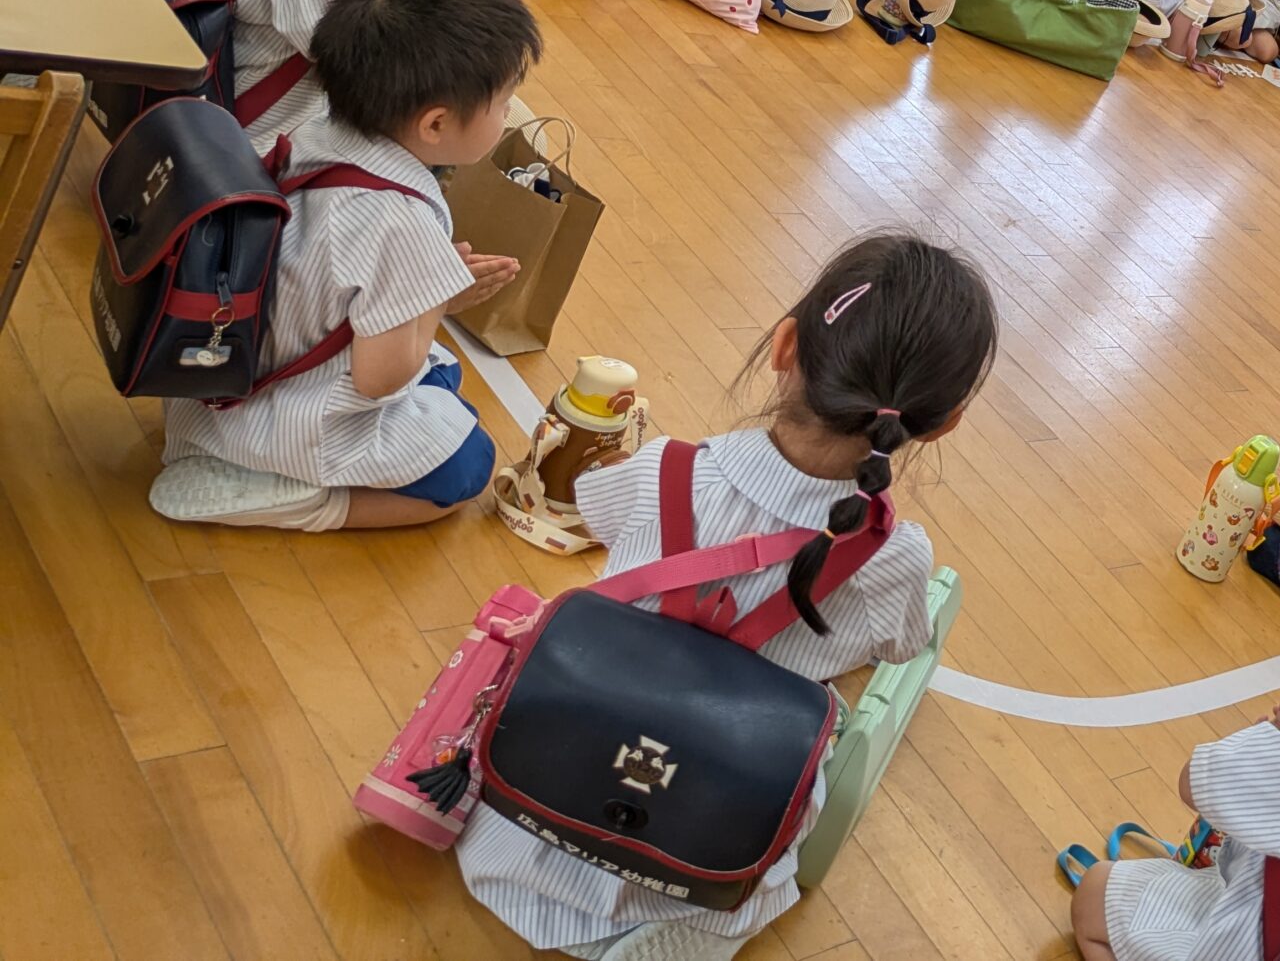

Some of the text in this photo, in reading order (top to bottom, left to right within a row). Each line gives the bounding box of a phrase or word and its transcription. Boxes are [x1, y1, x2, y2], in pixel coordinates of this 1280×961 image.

[517, 813, 690, 898] 広島マリア幼稚園
